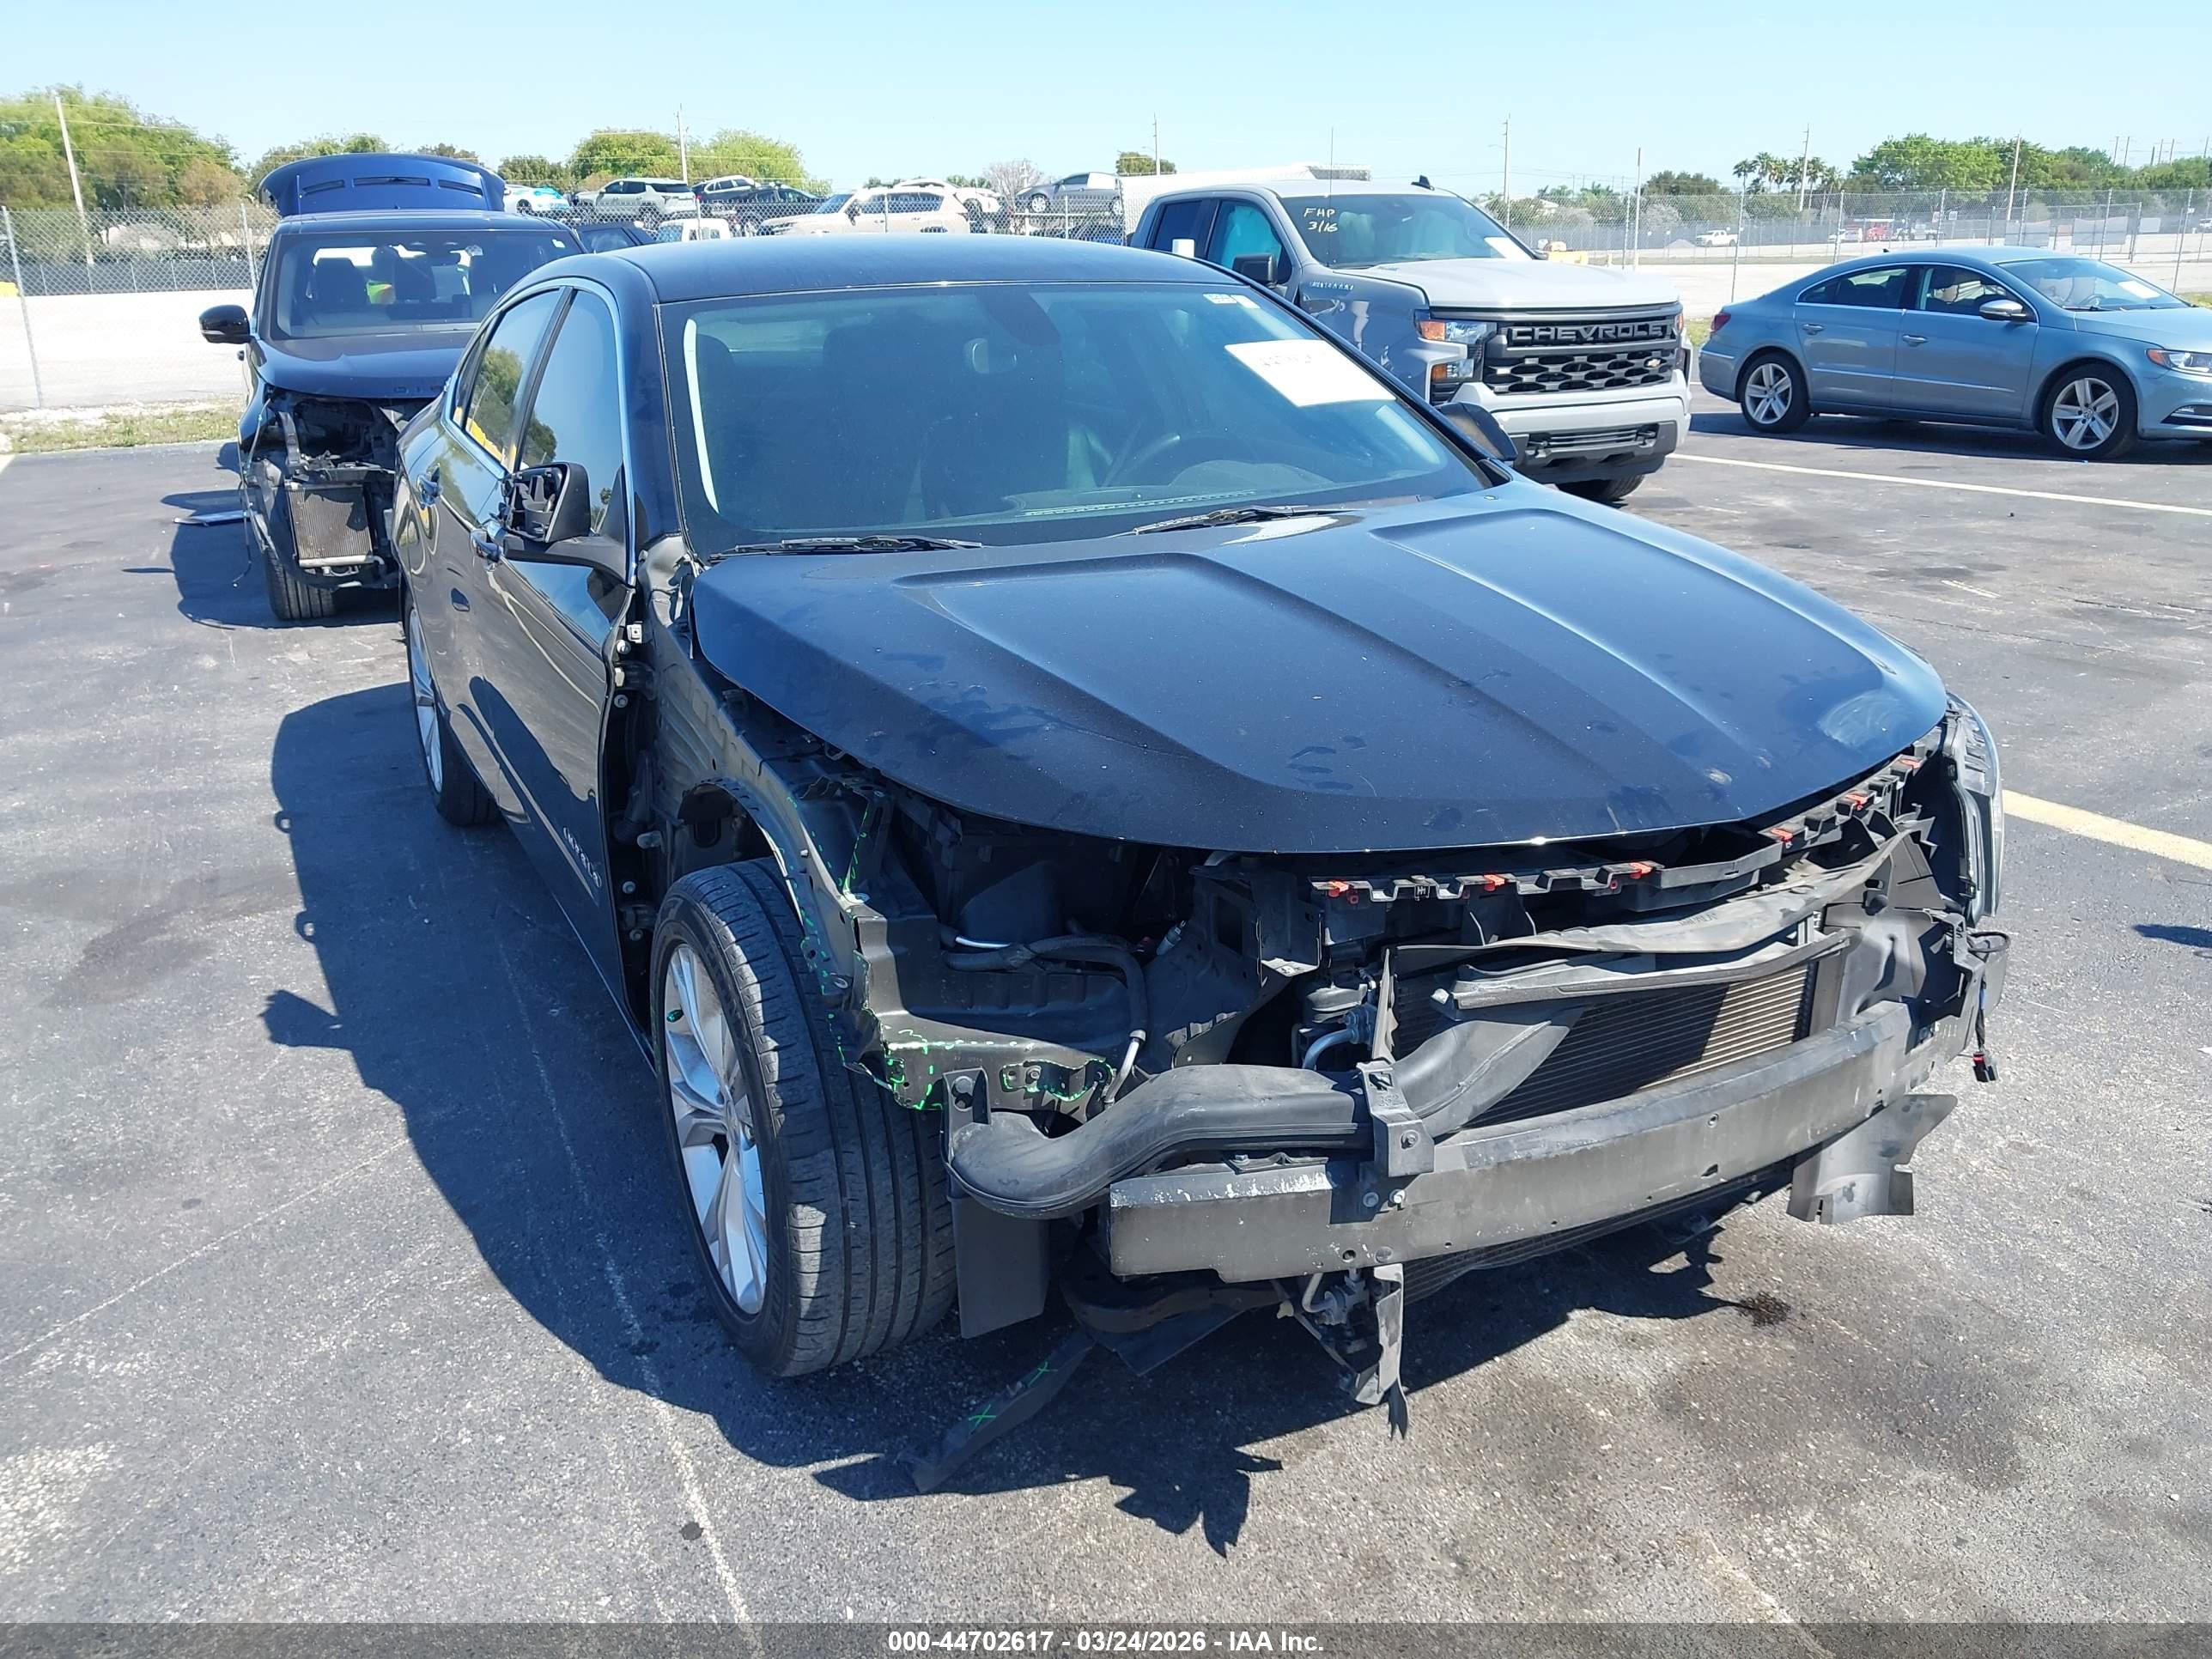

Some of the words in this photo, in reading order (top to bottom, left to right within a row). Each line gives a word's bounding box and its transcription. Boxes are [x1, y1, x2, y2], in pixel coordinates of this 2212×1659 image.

[1304, 208, 1335, 218] FHP
[1308, 220, 1338, 234] 3/16
[1510, 320, 1677, 341] CHEVROLET
